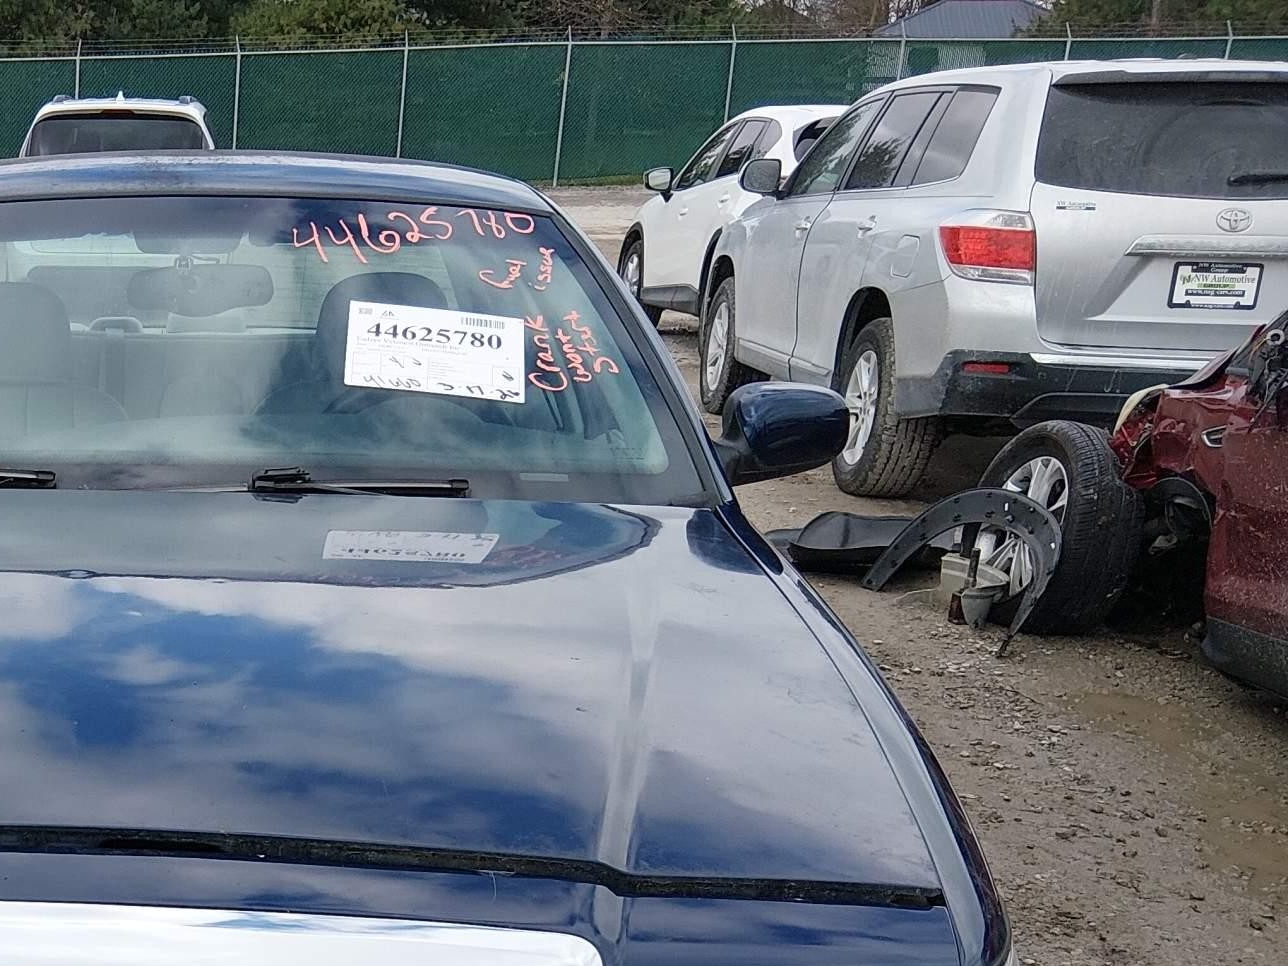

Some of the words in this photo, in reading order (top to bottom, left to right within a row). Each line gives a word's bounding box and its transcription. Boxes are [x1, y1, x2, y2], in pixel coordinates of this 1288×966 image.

[292, 207, 535, 264] 44625780
[1210, 274, 1256, 283] Automotive
[367, 322, 502, 350] 44625780
